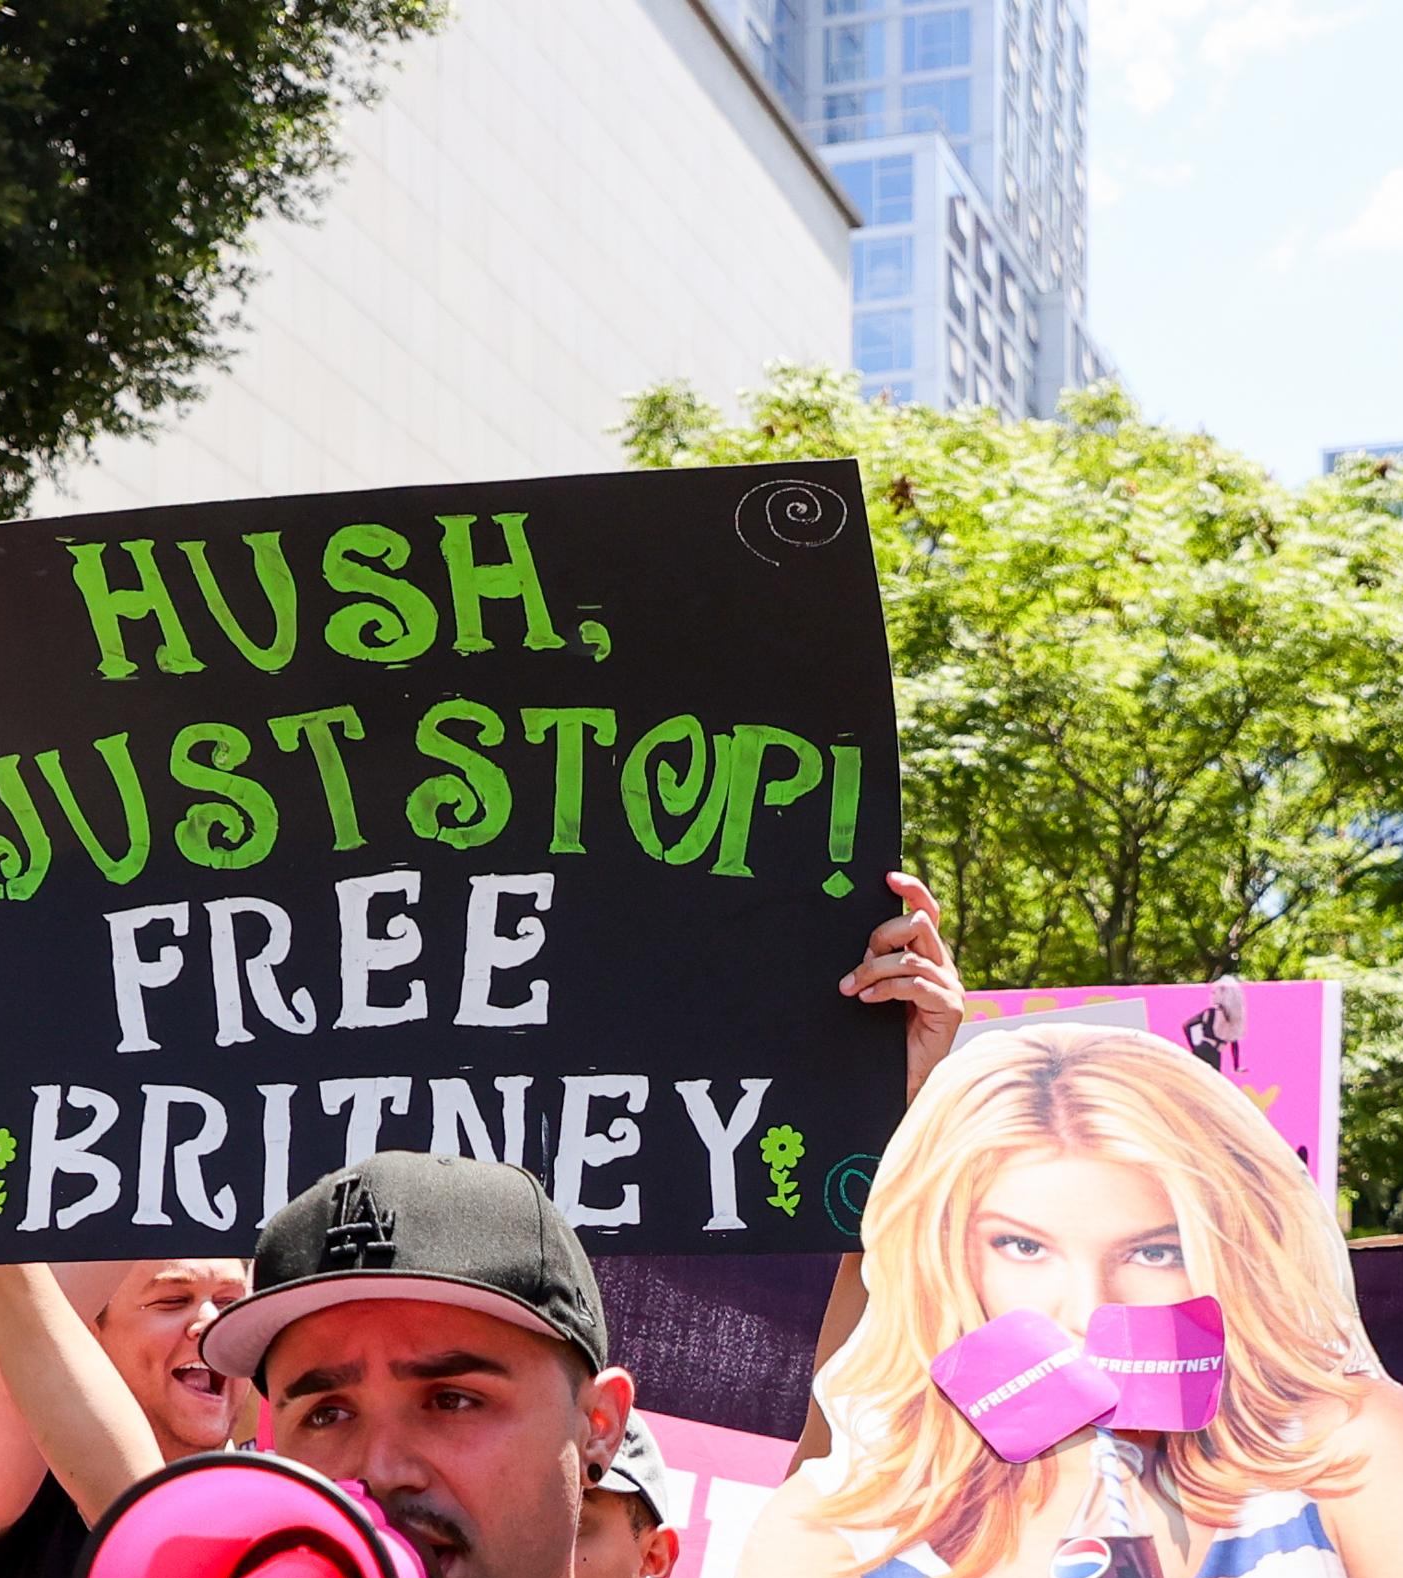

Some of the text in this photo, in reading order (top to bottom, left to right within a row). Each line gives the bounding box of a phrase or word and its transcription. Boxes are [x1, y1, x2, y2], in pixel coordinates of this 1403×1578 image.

[57, 511, 612, 679] HUSH,
[405, 697, 862, 899] STOP!
[103, 869, 555, 1054] FREE
[17, 1073, 773, 1234] BRITNEY
[324, 1173, 396, 1258] LA
